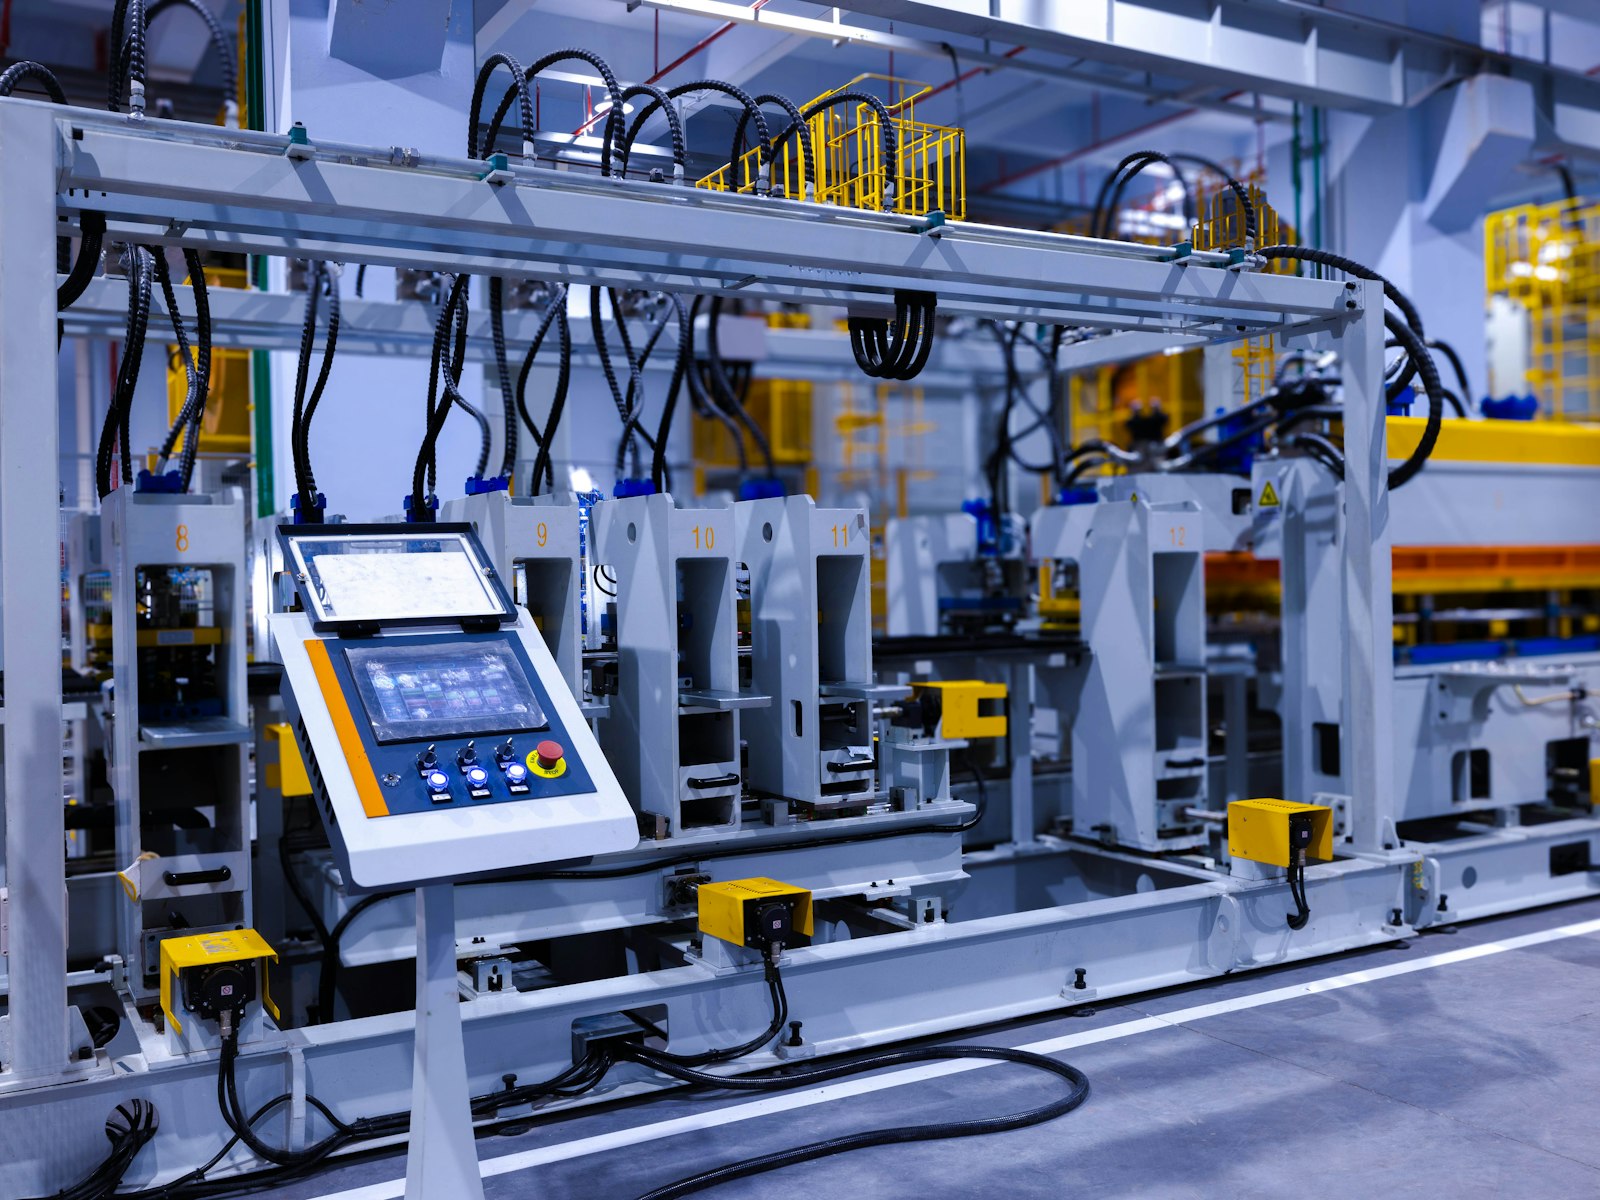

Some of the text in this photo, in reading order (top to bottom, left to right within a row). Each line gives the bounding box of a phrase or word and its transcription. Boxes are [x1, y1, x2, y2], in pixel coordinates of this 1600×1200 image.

[175, 523, 189, 553] 8
[537, 522, 547, 548] 9
[691, 525, 715, 550] 10
[831, 523, 848, 548] 11
[1169, 526, 1186, 548] 12
